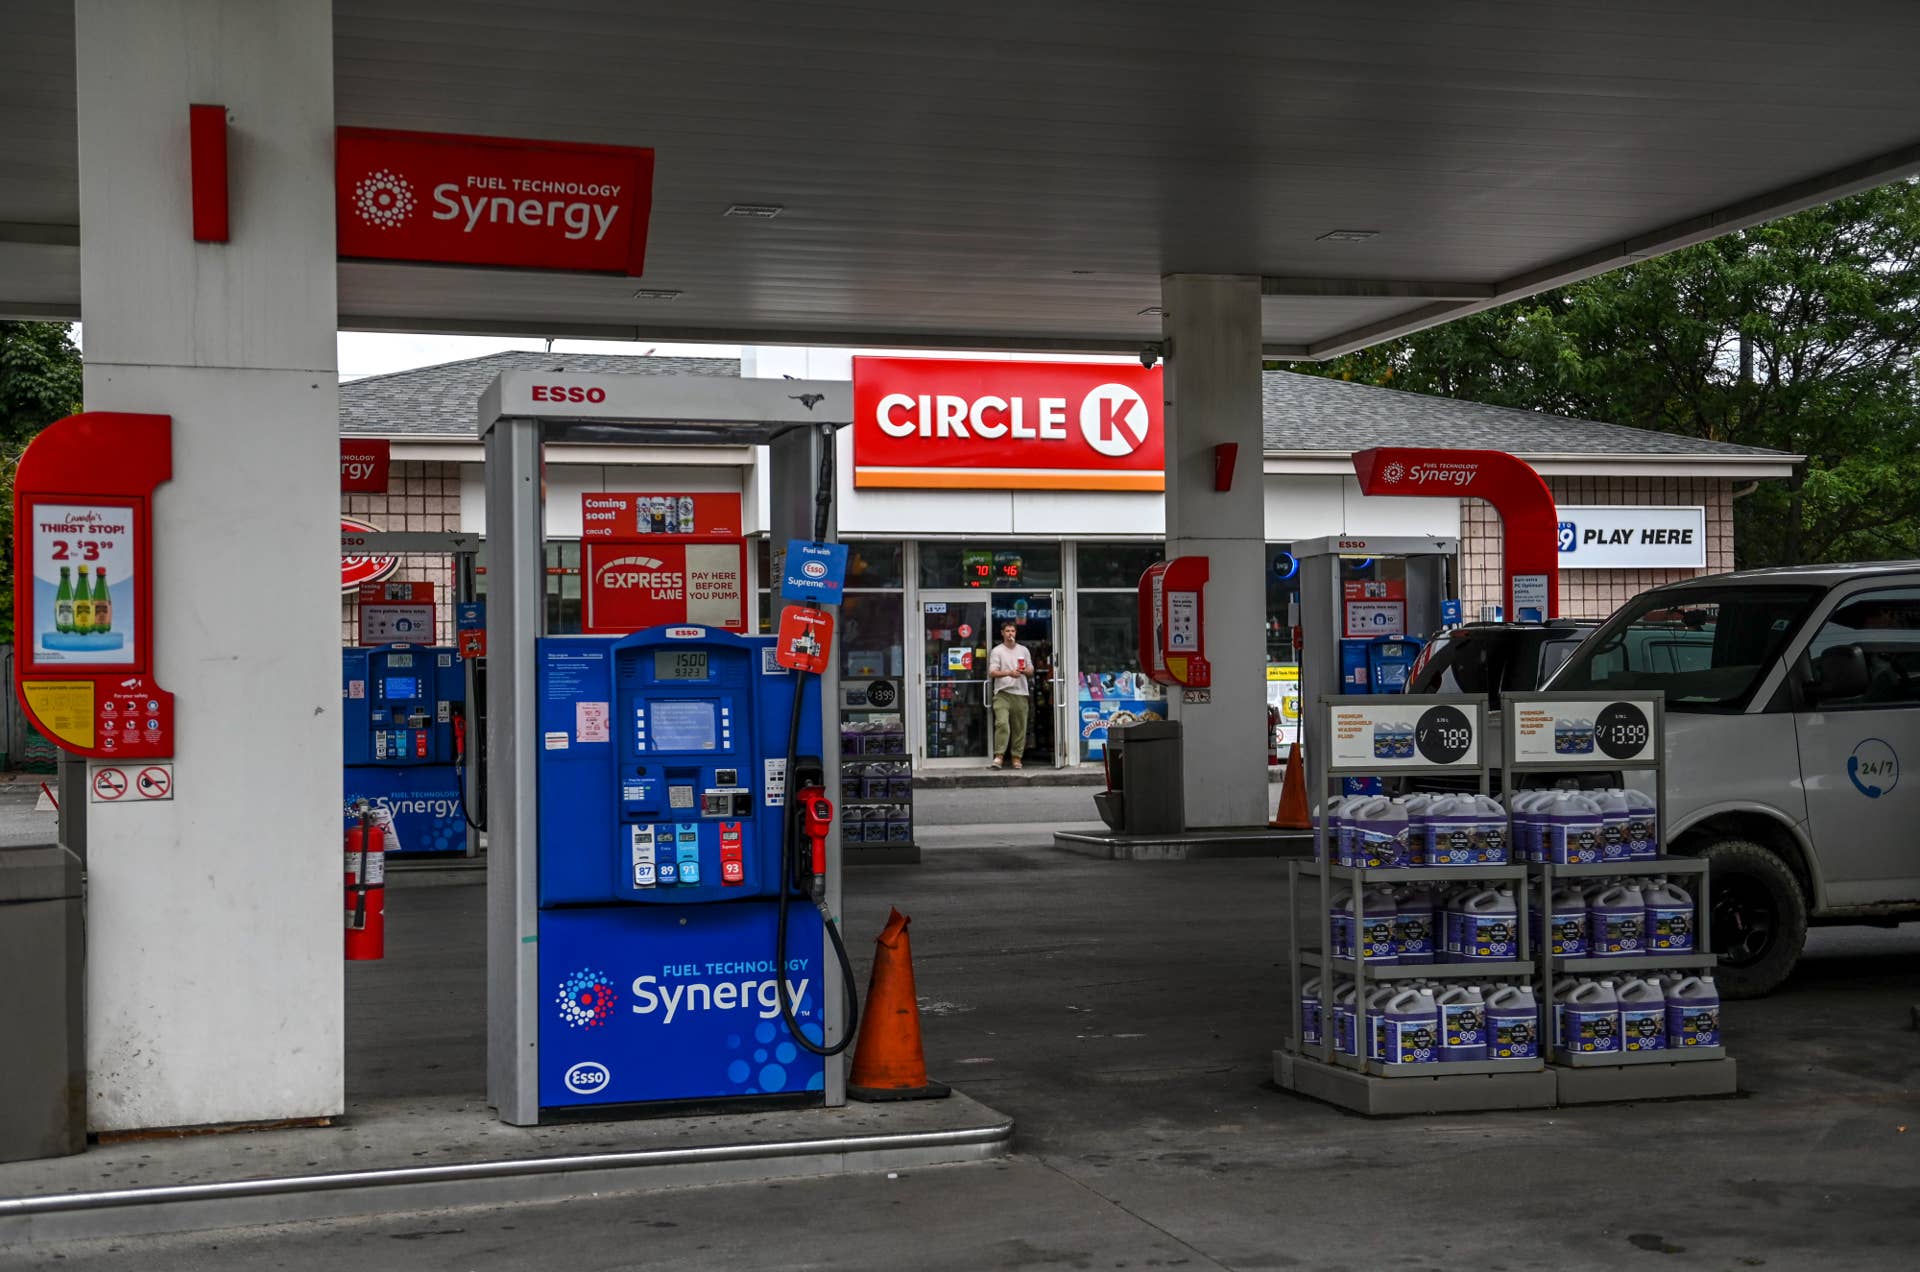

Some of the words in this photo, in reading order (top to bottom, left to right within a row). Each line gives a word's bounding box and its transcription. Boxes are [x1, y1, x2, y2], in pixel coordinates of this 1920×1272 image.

[467, 175, 506, 190] FUEL
[512, 178, 621, 197] TECHNOLOGY
[432, 183, 619, 240] Synergy
[532, 385, 606, 403] ESSO
[875, 393, 1067, 440] CIRCLE
[1098, 397, 1144, 452] K
[1408, 465, 1477, 486] Synergy
[585, 498, 627, 510] Coming
[585, 511, 616, 521] soon!
[40, 523, 84, 534] THIRST
[88, 524, 125, 535] STOP!
[1583, 529, 1634, 544] PLAY
[1640, 529, 1693, 544] HERE
[52, 540, 69, 560] 2
[1338, 541, 1366, 549] ESSO
[805, 564, 823, 574] Esso
[976, 565, 989, 576] 70
[1003, 565, 1018, 576] 46
[604, 573, 683, 588] EXPRESS
[691, 572, 708, 580] PAY
[711, 572, 737, 580] HERE
[695, 582, 733, 590] BEFORE
[651, 589, 683, 600] LANE
[689, 592, 710, 600] YOU
[711, 592, 739, 600] PUMP.
[1438, 728, 1469, 749] 7.89
[1612, 725, 1646, 744] 13.99
[1862, 760, 1893, 776] 24/7
[377, 797, 460, 818] Synergy
[638, 866, 651, 876] 87
[660, 865, 674, 876] 89
[683, 865, 695, 875] 91
[726, 864, 739, 873] 93
[663, 964, 701, 977] FUEL
[632, 975, 809, 1024] Synergy
[572, 1070, 604, 1085] Esso
